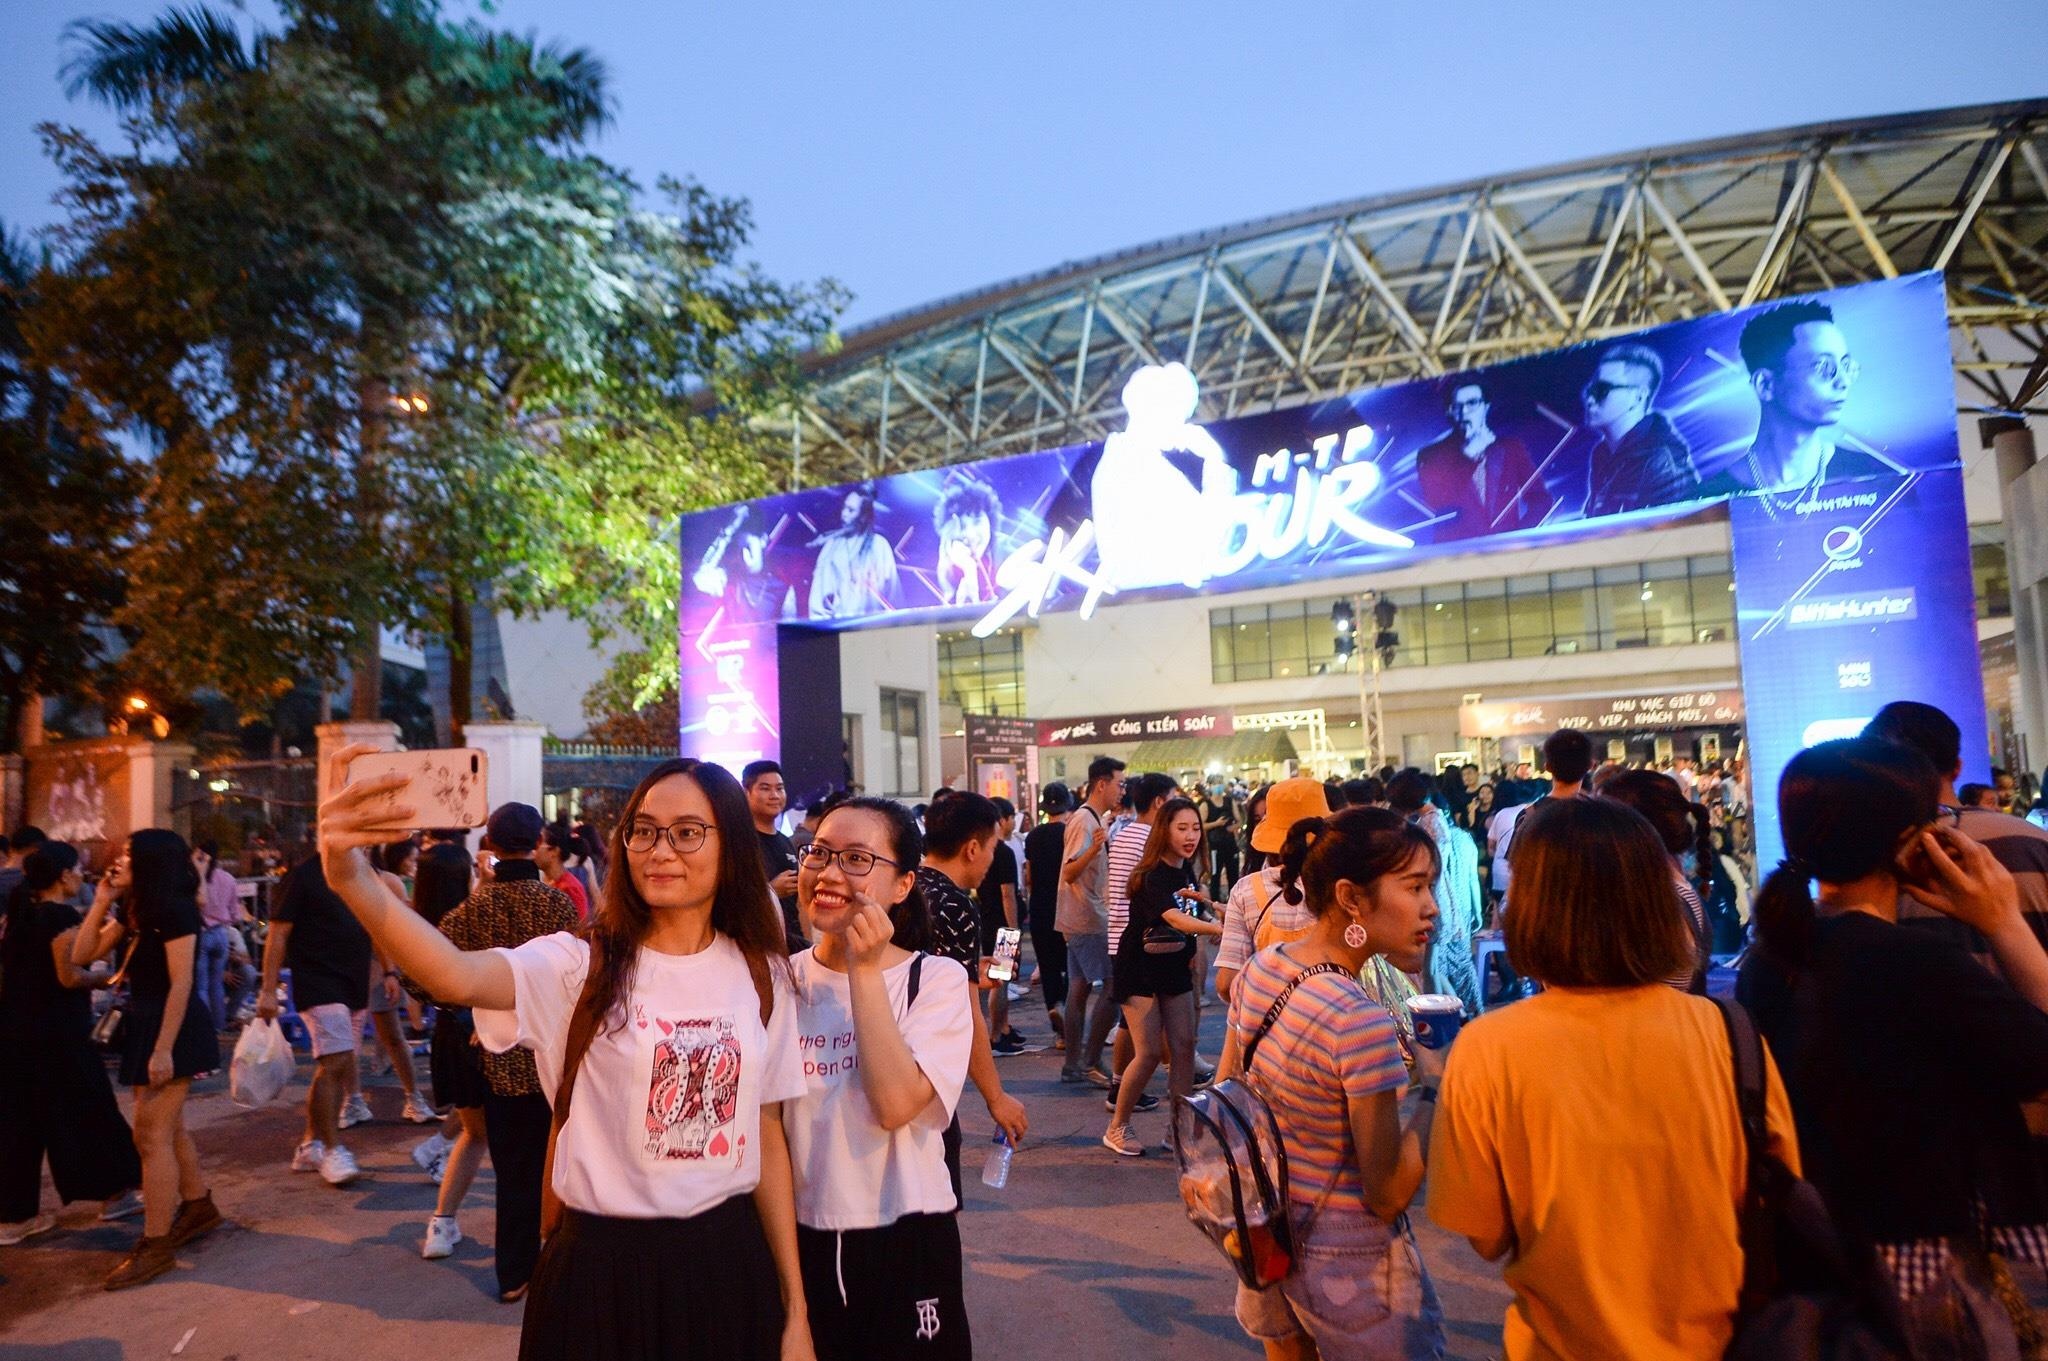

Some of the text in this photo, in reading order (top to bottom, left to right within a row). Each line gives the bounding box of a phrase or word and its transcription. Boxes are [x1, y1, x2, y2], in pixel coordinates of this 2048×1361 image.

[1251, 424, 1374, 487] M-TP
[1612, 699, 1636, 712] KHU
[1184, 714, 1216, 731] SOÁT
[799, 1031, 856, 1050] the rig
